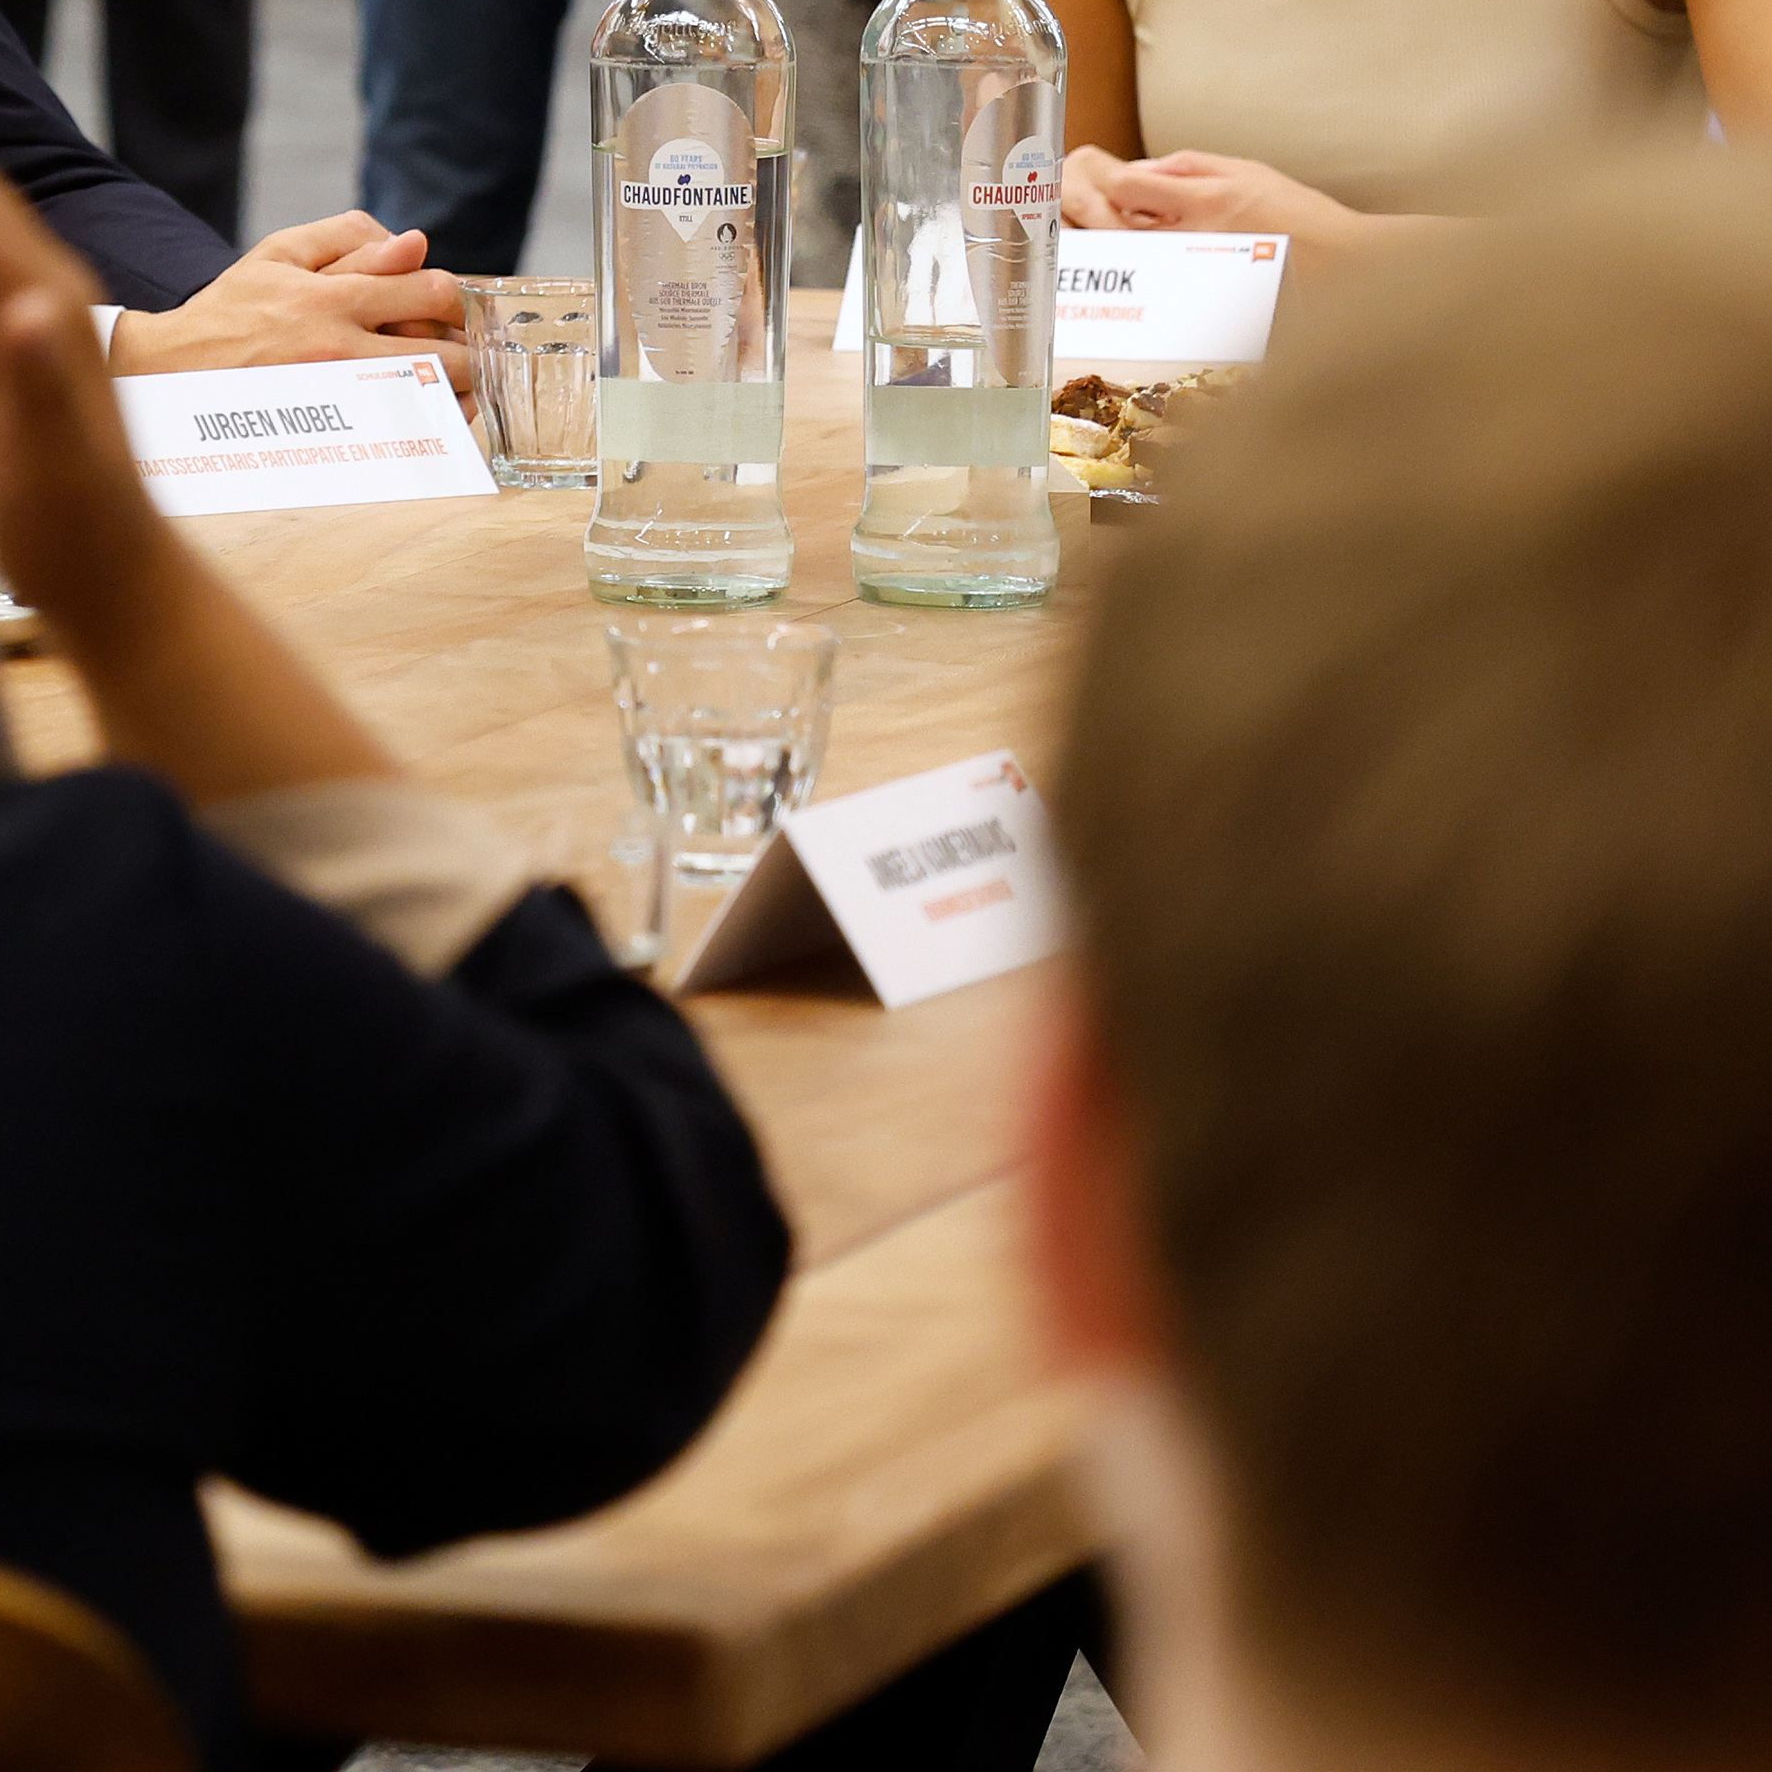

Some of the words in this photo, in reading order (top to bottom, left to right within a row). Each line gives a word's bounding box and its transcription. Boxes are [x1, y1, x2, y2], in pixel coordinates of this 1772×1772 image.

[624, 185, 748, 206] CHAUDFONTAINE
[1056, 268, 1136, 294] EENOK
[194, 410, 278, 441] JURGEN
[276, 404, 353, 434] NOBEL
[135, 452, 260, 478] TAATSSECRETARIS
[258, 445, 350, 468] PARTICIPATIE
[348, 443, 370, 461] EN
[369, 438, 449, 460] INTEGRATIE
